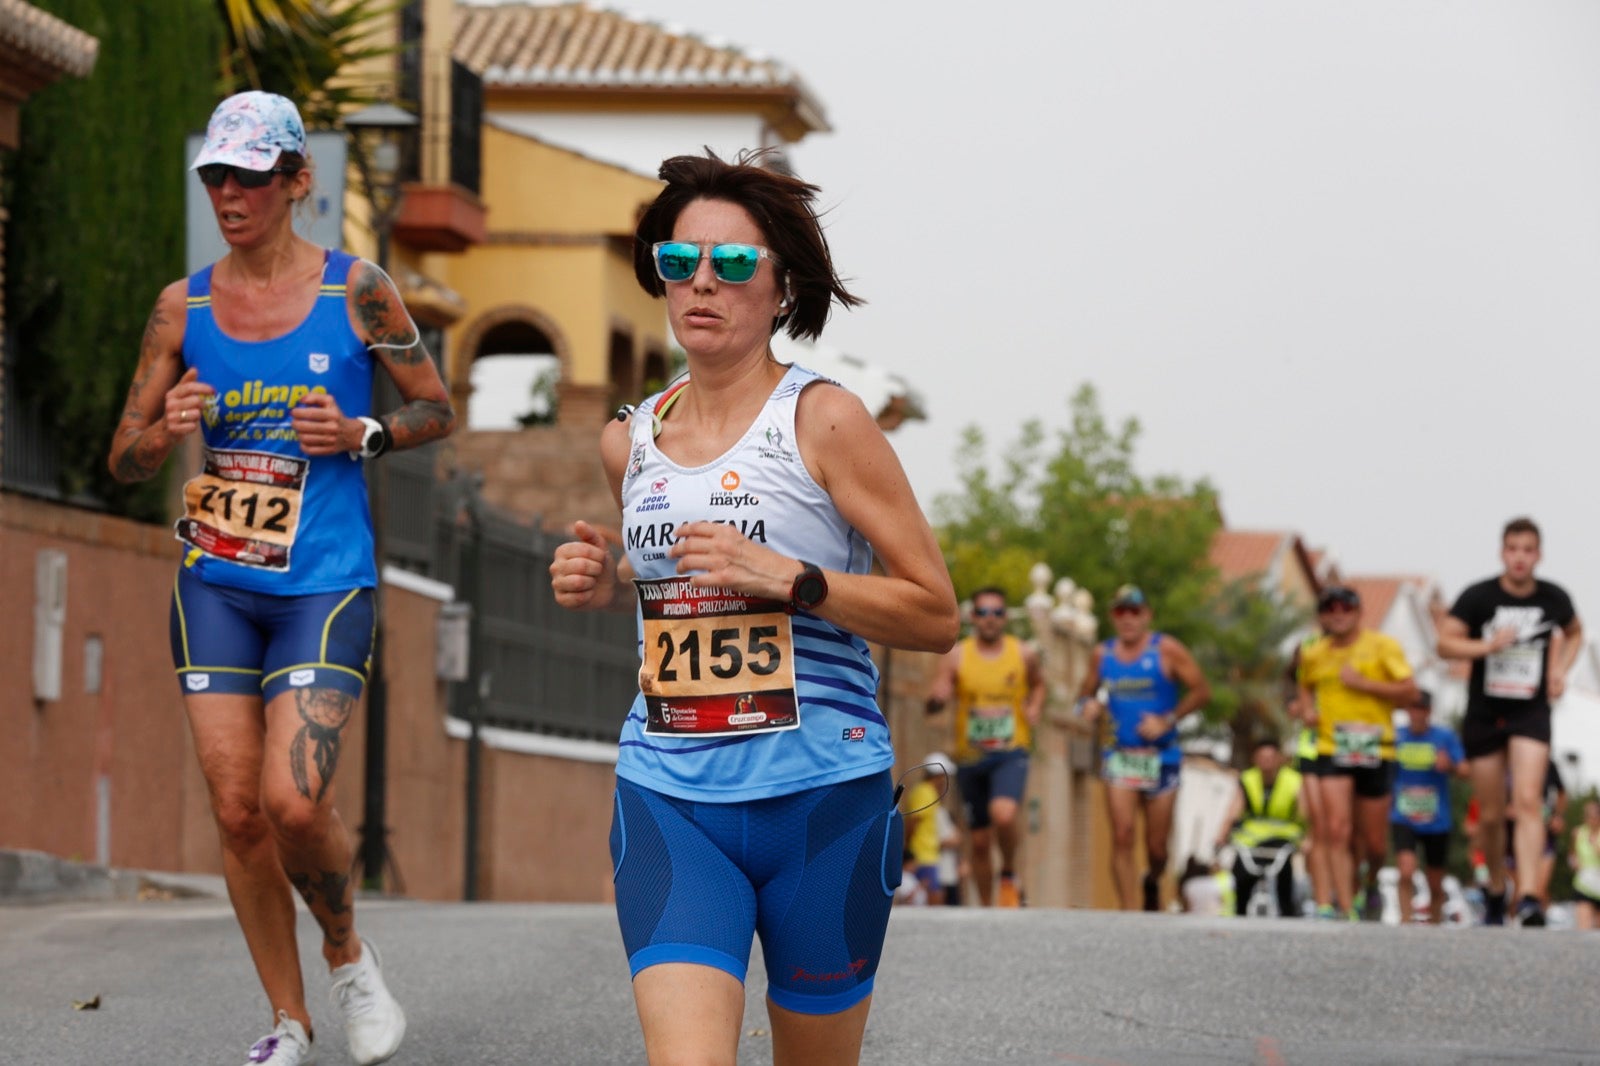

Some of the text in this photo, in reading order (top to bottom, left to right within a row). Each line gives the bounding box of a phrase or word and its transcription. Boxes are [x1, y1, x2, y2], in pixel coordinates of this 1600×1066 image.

[635, 502, 670, 513] GARRIDO
[642, 495, 667, 505] SPORT
[709, 493, 760, 509] mayfo
[201, 485, 290, 534] 2112
[627, 519, 768, 551] MARNA
[642, 552, 666, 562] CLUB
[679, 580, 720, 600] PREMIO
[697, 600, 747, 614] CRUZCAMPO
[657, 625, 781, 682] 2155
